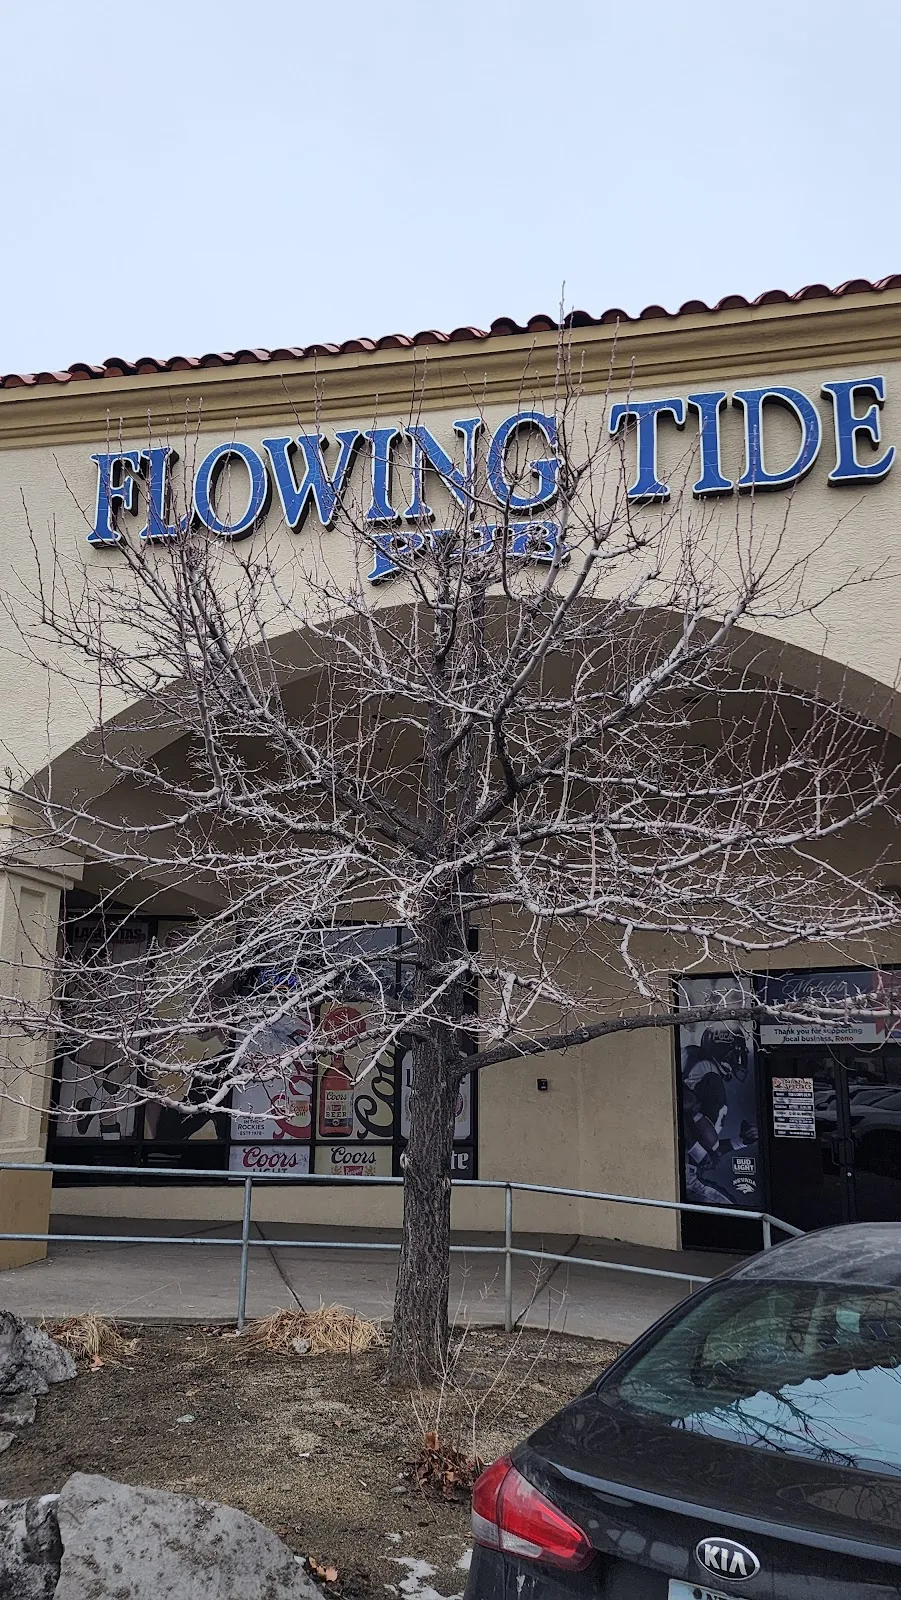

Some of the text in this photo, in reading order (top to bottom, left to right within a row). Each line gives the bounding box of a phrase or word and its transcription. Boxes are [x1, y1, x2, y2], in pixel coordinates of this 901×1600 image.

[86, 375, 898, 548] FLOWING TIDE
[366, 520, 569, 583] PUB
[822, 1028, 863, 1036] supporting
[326, 1091, 347, 1101] Coors
[242, 1146, 298, 1168] Coors
[330, 1146, 376, 1164] Coors
[732, 1177, 757, 1187] NEVADA
[704, 1543, 748, 1576] KIA
